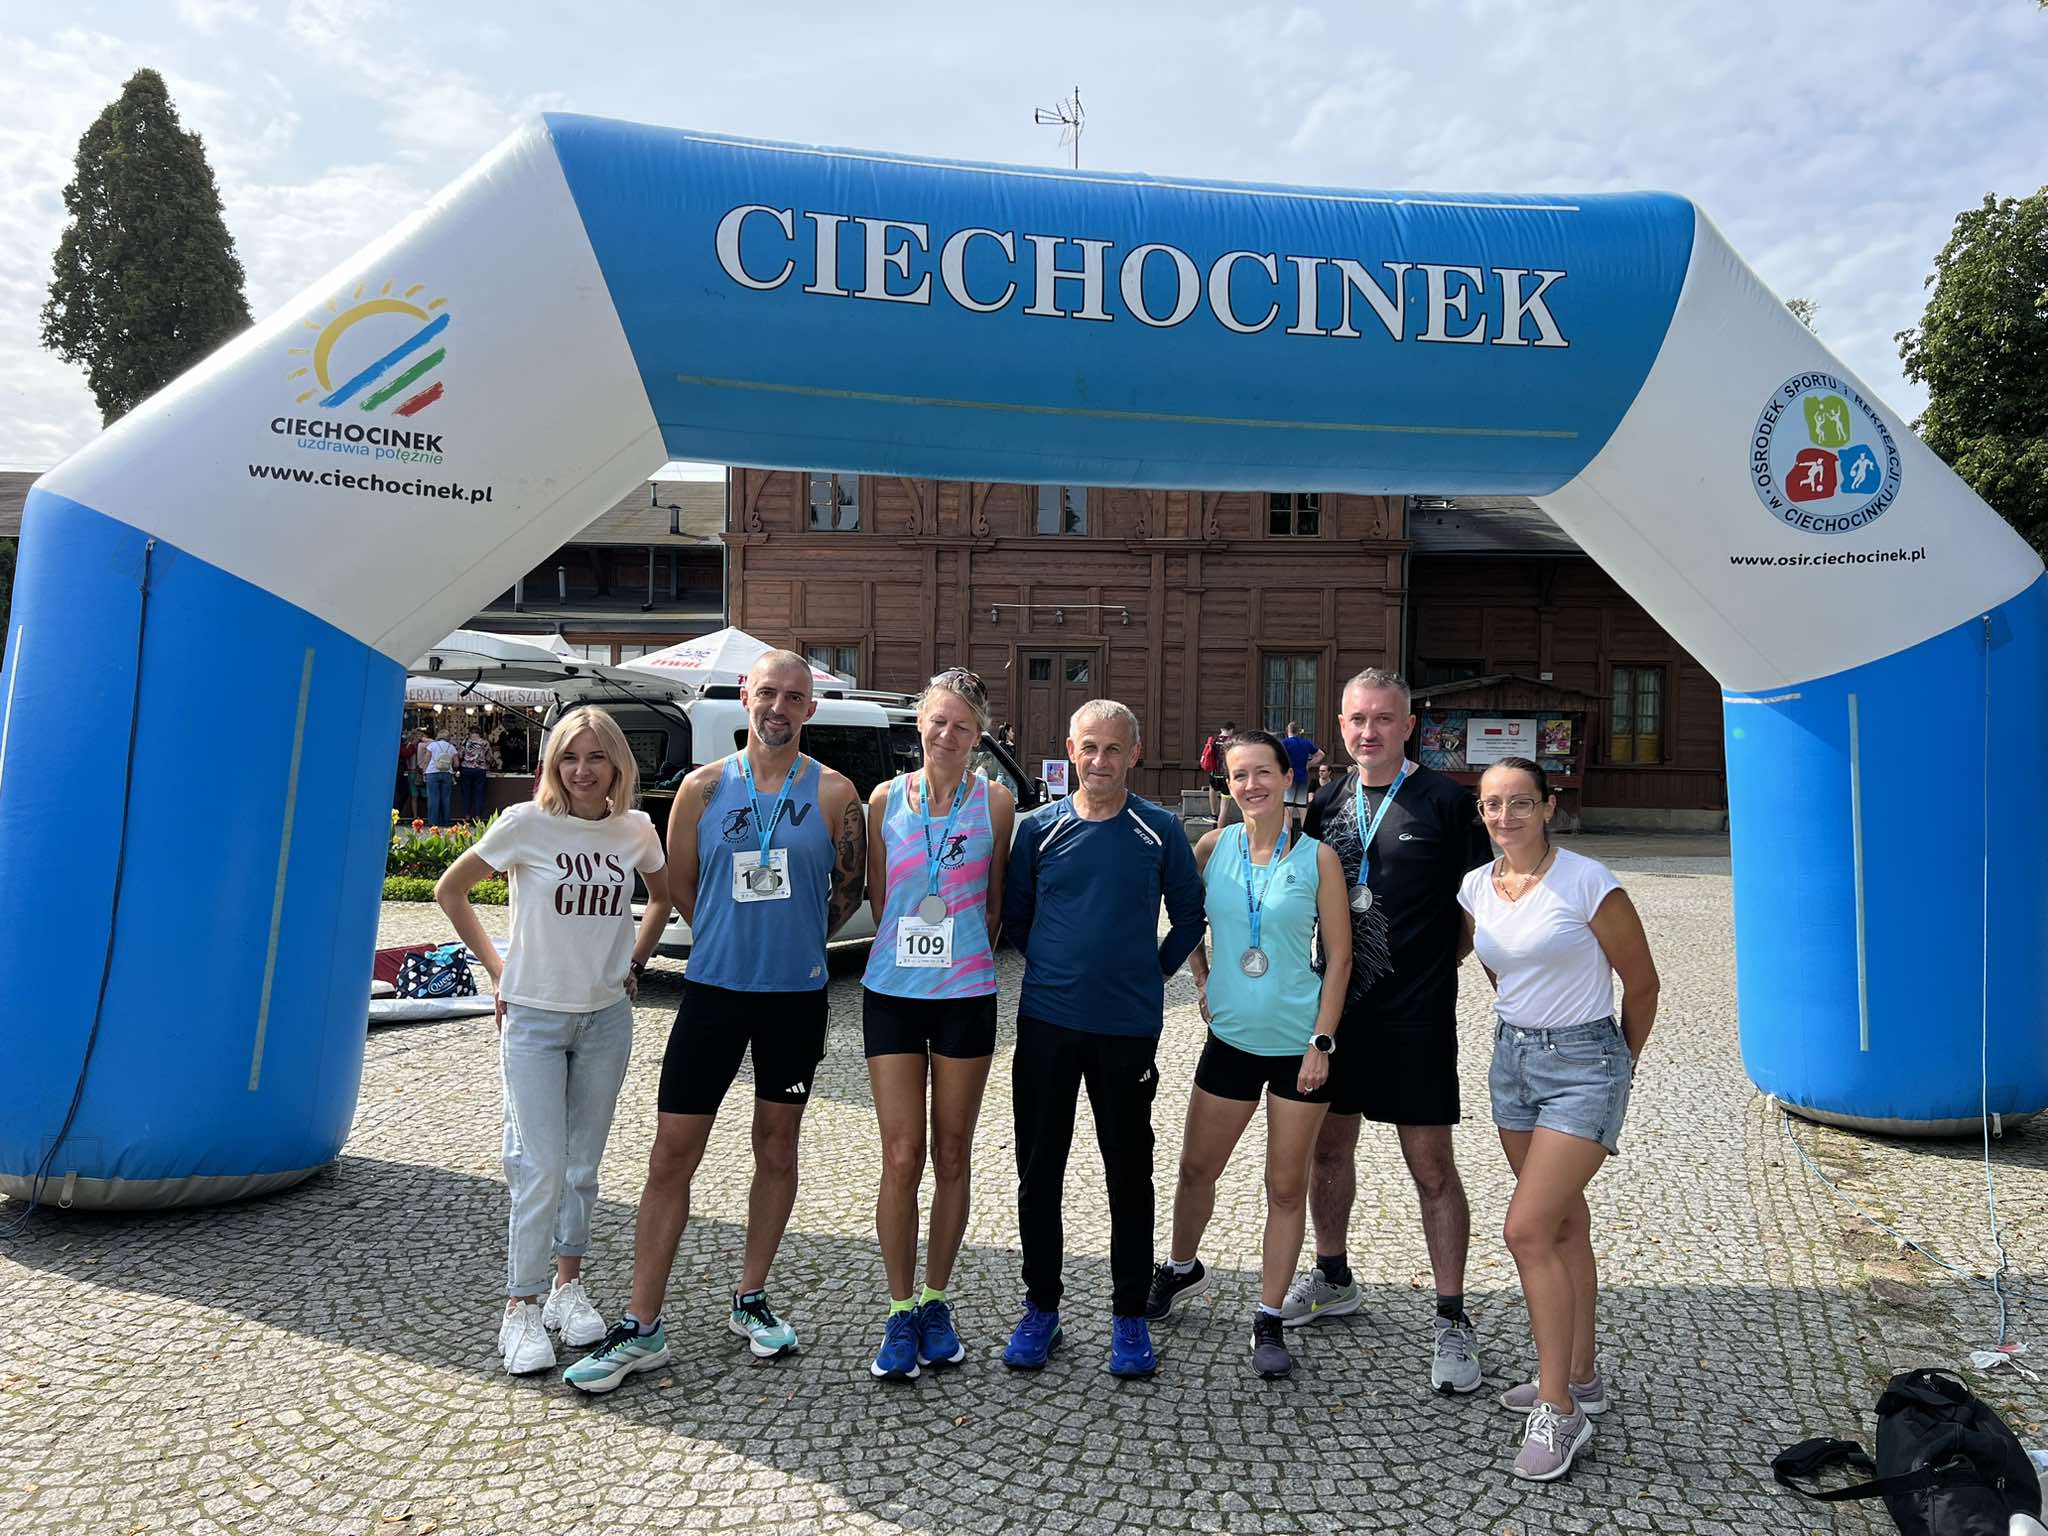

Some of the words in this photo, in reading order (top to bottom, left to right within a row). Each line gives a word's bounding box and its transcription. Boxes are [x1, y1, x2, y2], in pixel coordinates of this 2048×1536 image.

[714, 203, 1570, 348] CIECHOCINEK
[270, 417, 443, 453] CIECHOCINEK
[1752, 400, 1784, 486] OŚRODEK
[1784, 374, 1838, 398] SPORTU
[1854, 394, 1899, 482] REKREACJI
[297, 438, 370, 456] uzdrawia
[374, 447, 443, 465] potężnie
[248, 464, 493, 504] www.ciechocinek.pl
[1784, 488, 1893, 531] CIECHOCINKU
[1730, 547, 1926, 566] www.osir.ciechocinek.pl
[555, 852, 625, 882] 90'S
[742, 869, 783, 889] 15
[554, 882, 624, 917] GIRL
[906, 935, 944, 955] 109
